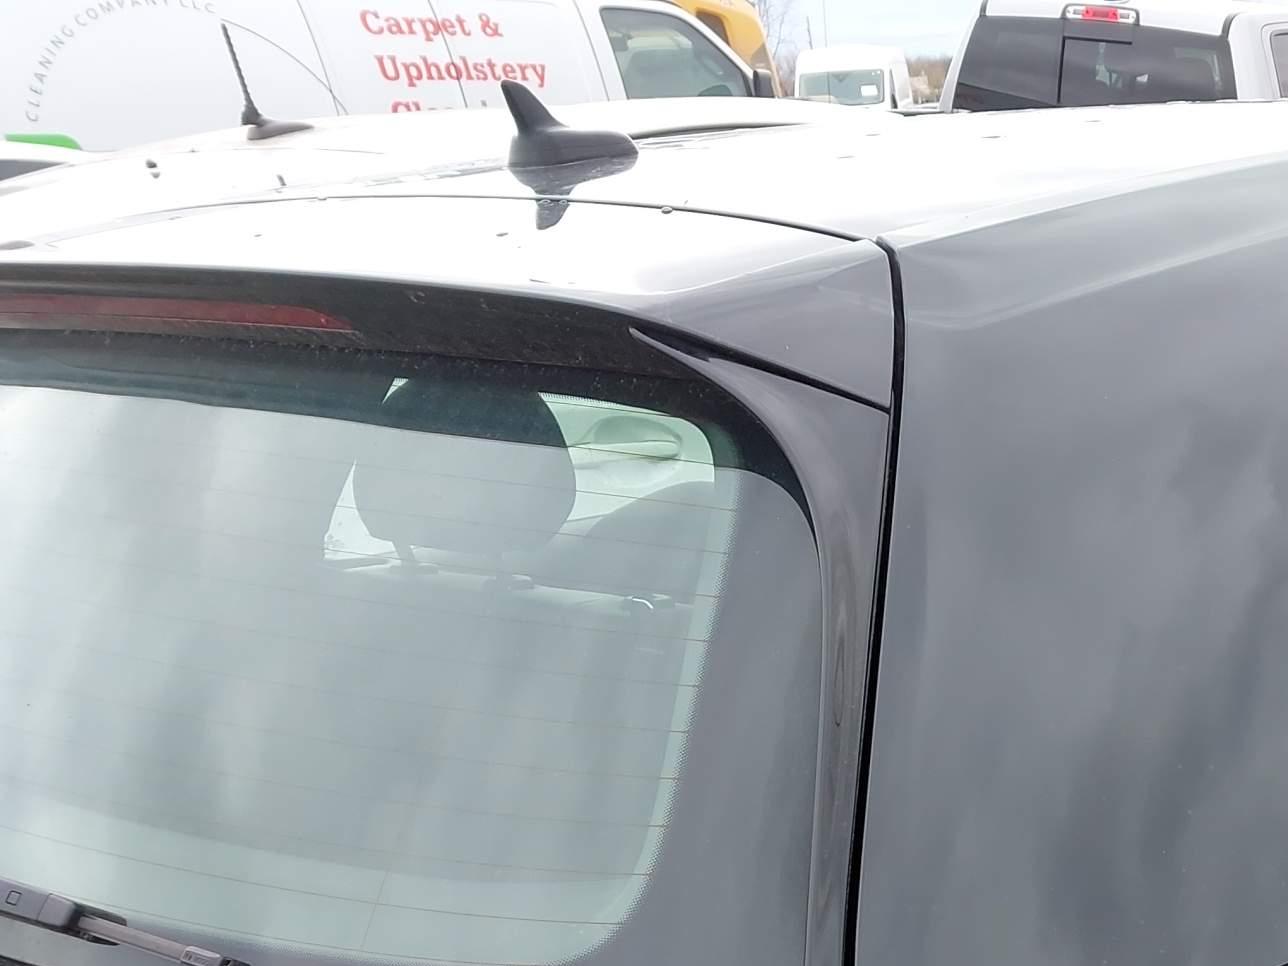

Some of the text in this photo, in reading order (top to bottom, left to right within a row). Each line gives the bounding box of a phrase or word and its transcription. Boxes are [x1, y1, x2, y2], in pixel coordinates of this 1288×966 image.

[359, 9, 504, 42] Carpet &
[25, 25, 75, 122] CLEANING
[373, 54, 547, 88] Upholstery
